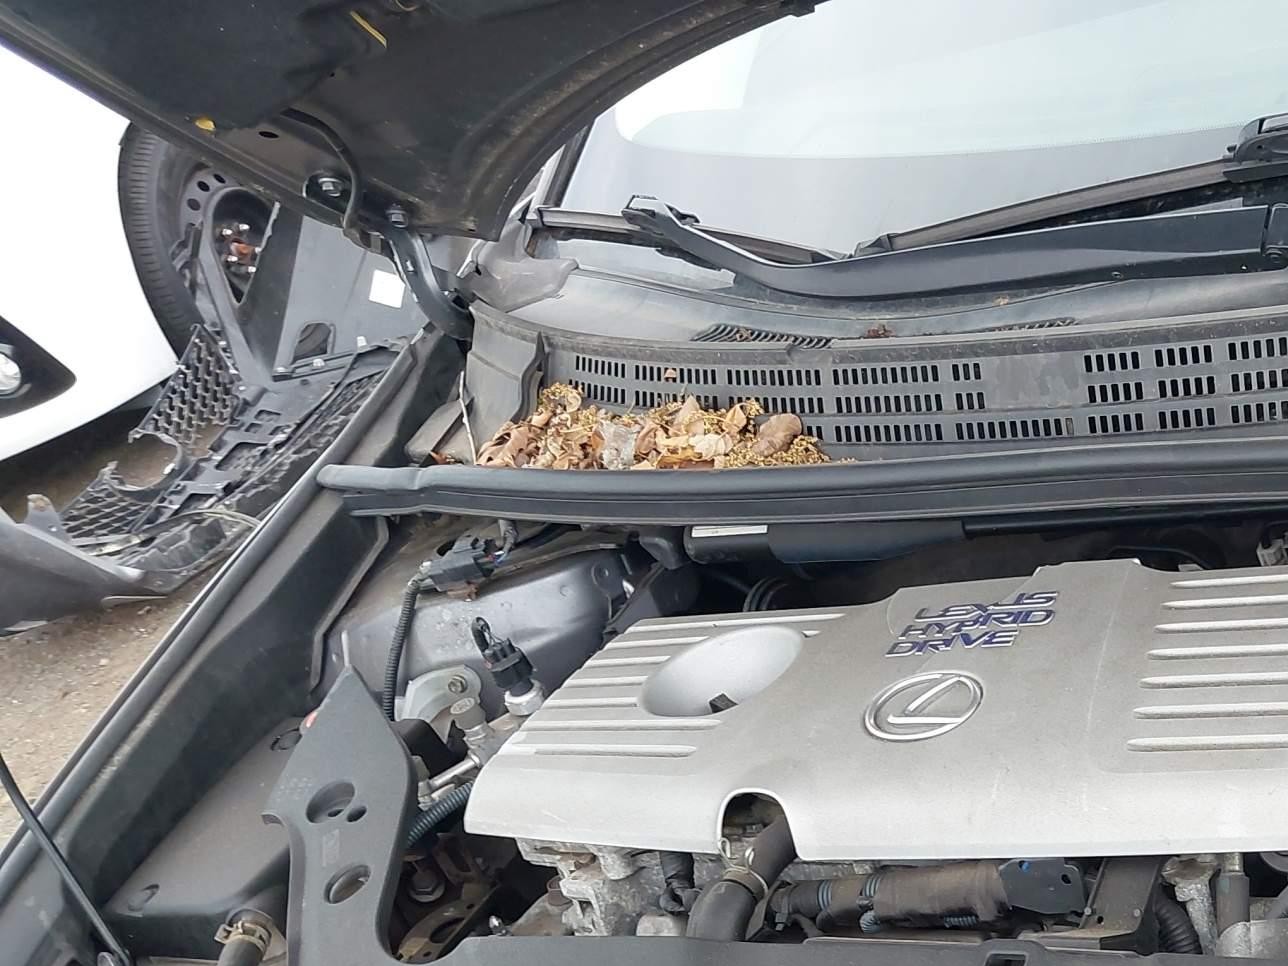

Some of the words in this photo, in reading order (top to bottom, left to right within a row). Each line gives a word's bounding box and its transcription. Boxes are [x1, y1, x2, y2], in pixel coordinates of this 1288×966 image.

[914, 591, 1058, 622] LEXUS
[899, 608, 1056, 640] HYBRID
[885, 629, 1020, 658] DRIVE
